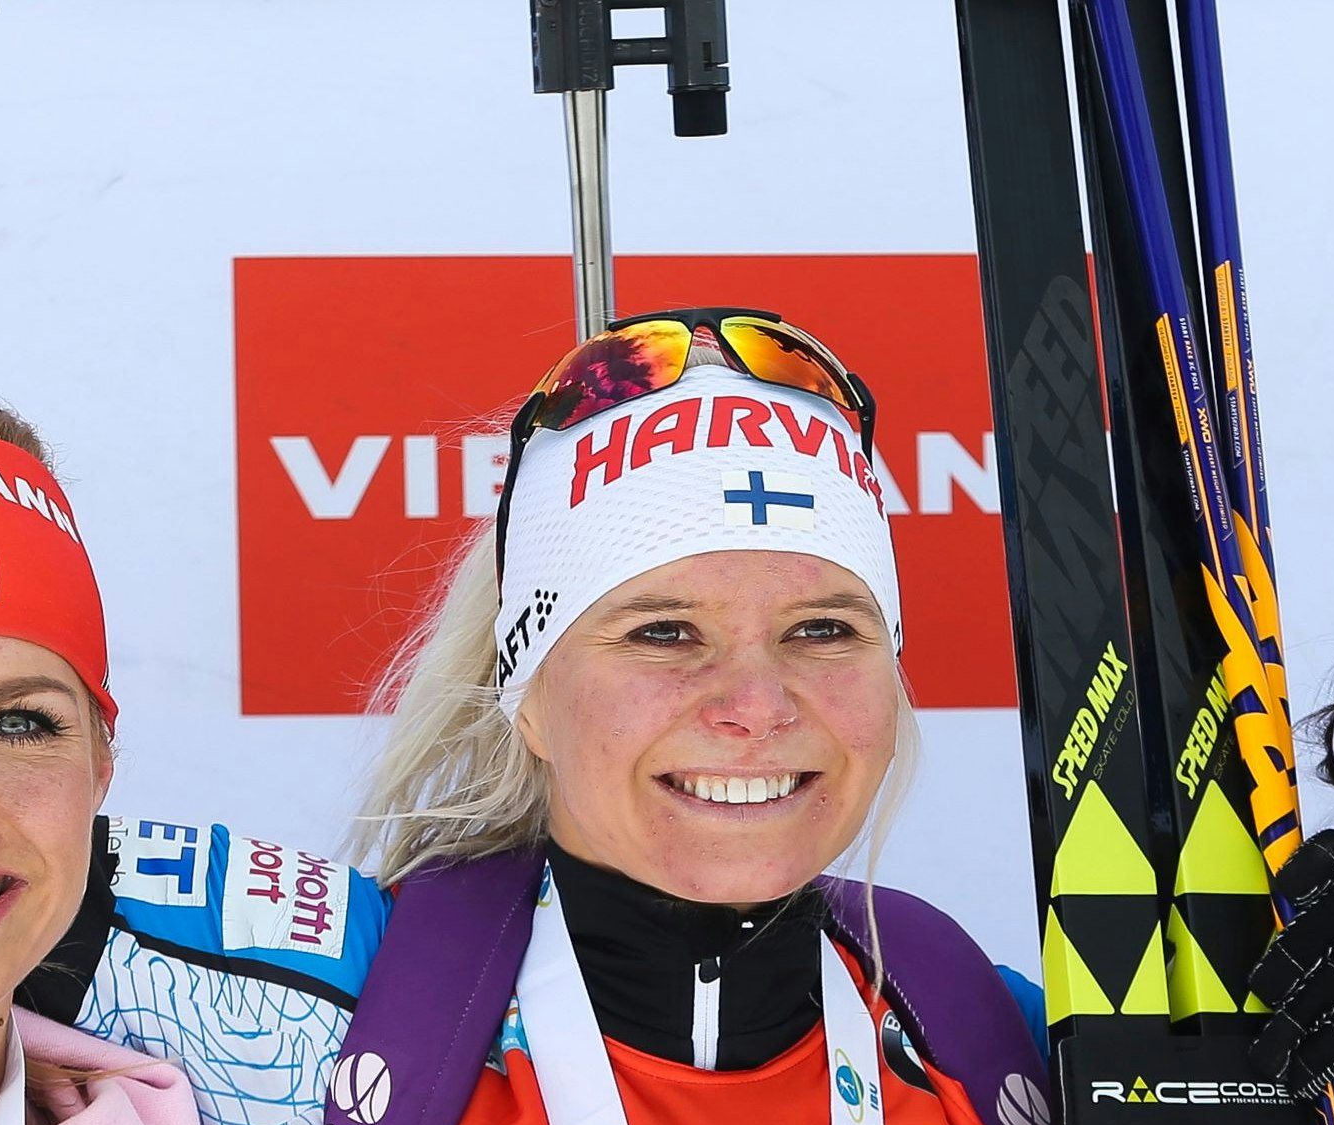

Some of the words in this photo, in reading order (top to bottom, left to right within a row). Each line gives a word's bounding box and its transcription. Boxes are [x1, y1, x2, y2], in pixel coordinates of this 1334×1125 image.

[1052, 706, 1099, 801] SPEED
[1085, 640, 1128, 723] MAX
[1175, 706, 1218, 800] SPEED
[870, 1082, 880, 1111] IBU
